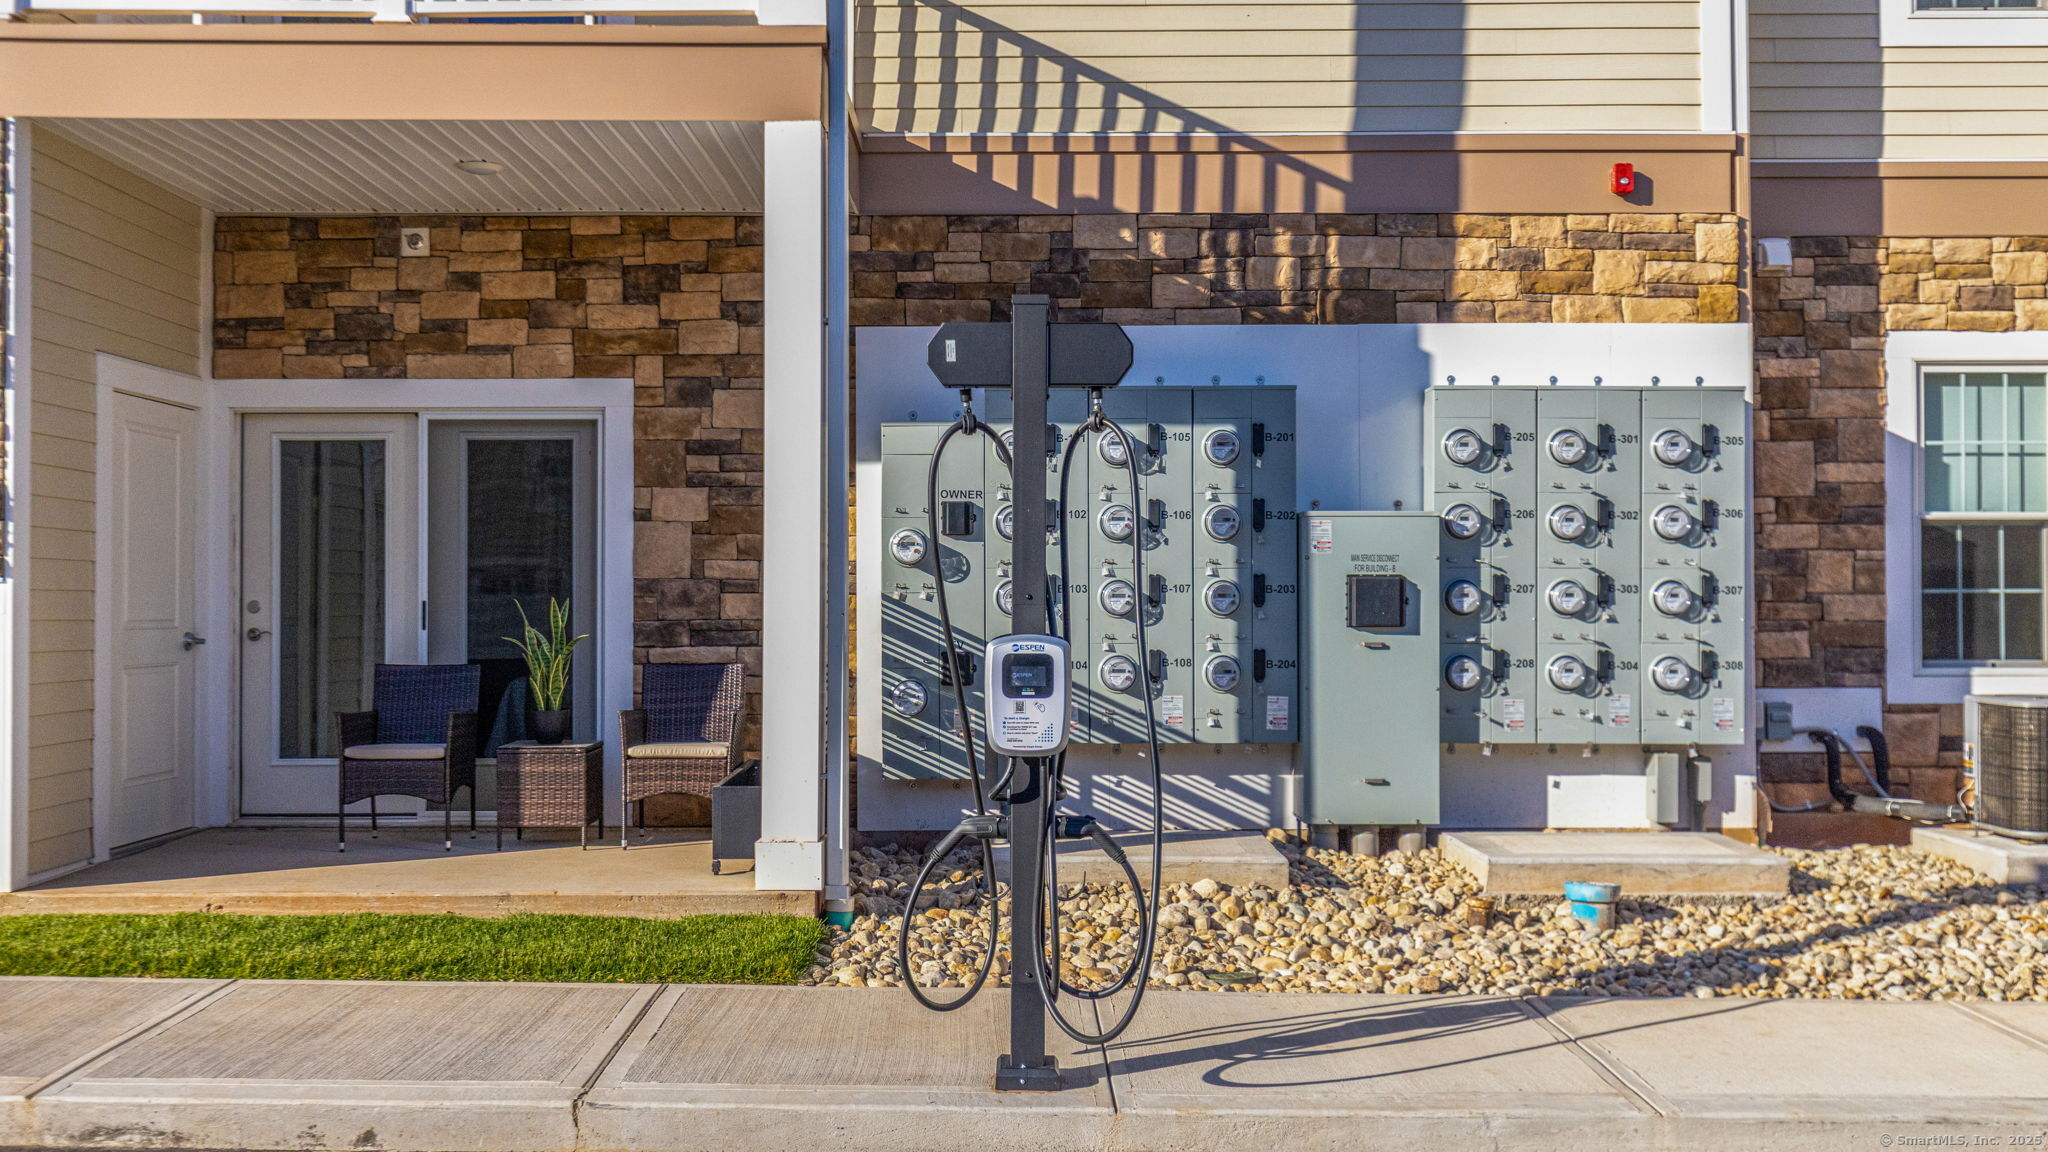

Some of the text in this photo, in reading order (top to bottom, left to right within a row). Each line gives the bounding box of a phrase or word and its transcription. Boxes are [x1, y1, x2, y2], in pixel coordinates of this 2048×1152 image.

[1057, 434, 1086, 443] B-11
[1161, 432, 1191, 443] B-105
[1265, 432, 1295, 442] B-201
[1504, 432, 1534, 442] B-205
[1609, 434, 1639, 444] B-301
[1714, 436, 1744, 446] B-305
[941, 490, 983, 500] OWNER
[1161, 510, 1192, 520] B-106
[1266, 510, 1295, 520] B-202
[1504, 509, 1535, 519] B-206
[1609, 510, 1639, 521] B-302
[1713, 509, 1743, 519] B-306
[1351, 554, 1399, 562] MAIN SERVICE DISCONNECT
[1058, 585, 1087, 593] B103
[1162, 584, 1191, 594] B-107
[1266, 584, 1296, 594] B-203
[1504, 584, 1535, 594] B-207
[1609, 584, 1639, 594] B-303
[1713, 585, 1743, 596] B-307
[1162, 658, 1192, 668] B-108
[1266, 659, 1296, 669] B-204
[1504, 658, 1534, 669] B-208
[1609, 661, 1639, 671] B-304
[1713, 659, 1743, 670] B-308
